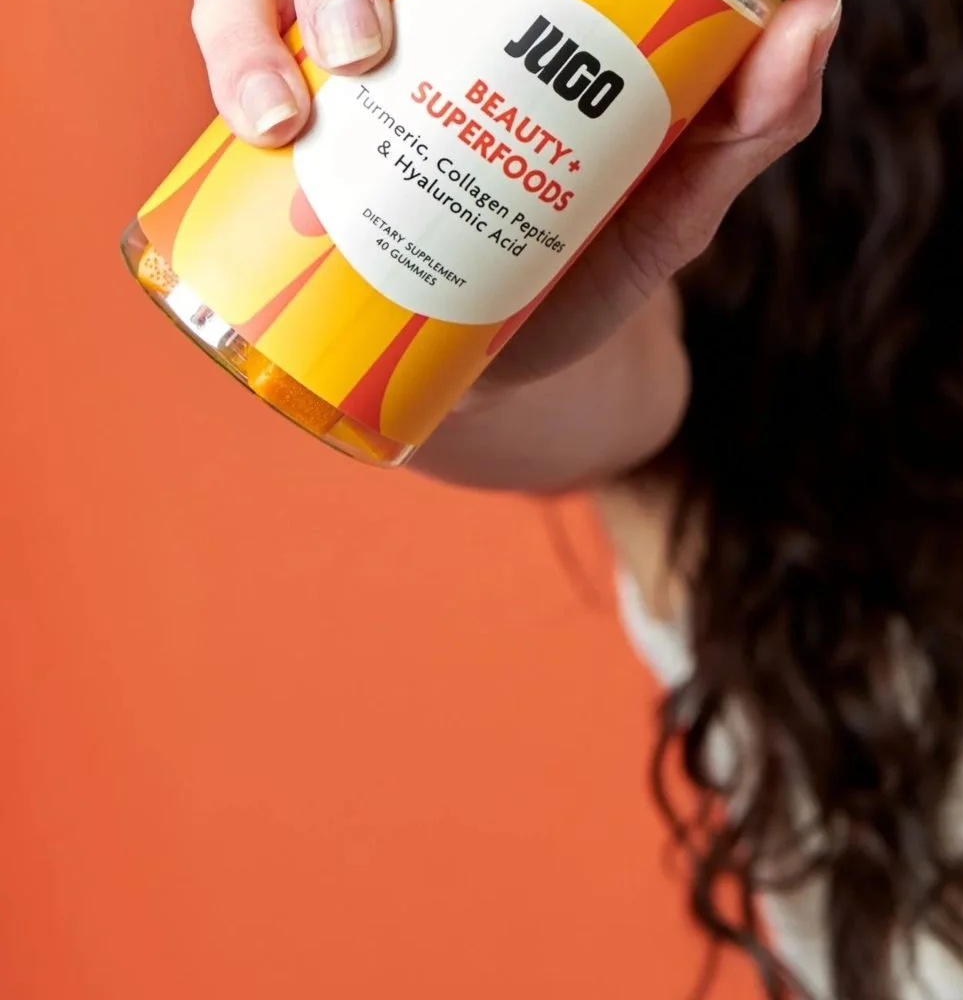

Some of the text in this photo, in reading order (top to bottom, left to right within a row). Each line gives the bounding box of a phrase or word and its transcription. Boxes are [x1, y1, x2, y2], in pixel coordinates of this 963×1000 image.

[503, 14, 625, 120] JUGO
[356, 84, 566, 254] Turmeric, Collagen Peptides
[376, 139, 527, 257] & Hyaluronic Acid
[410, 80, 575, 212] SUPERFOODS
[361, 207, 467, 288] DIETARY SUPPLEMENT
[375, 238, 437, 287] 40 GUMMIES
